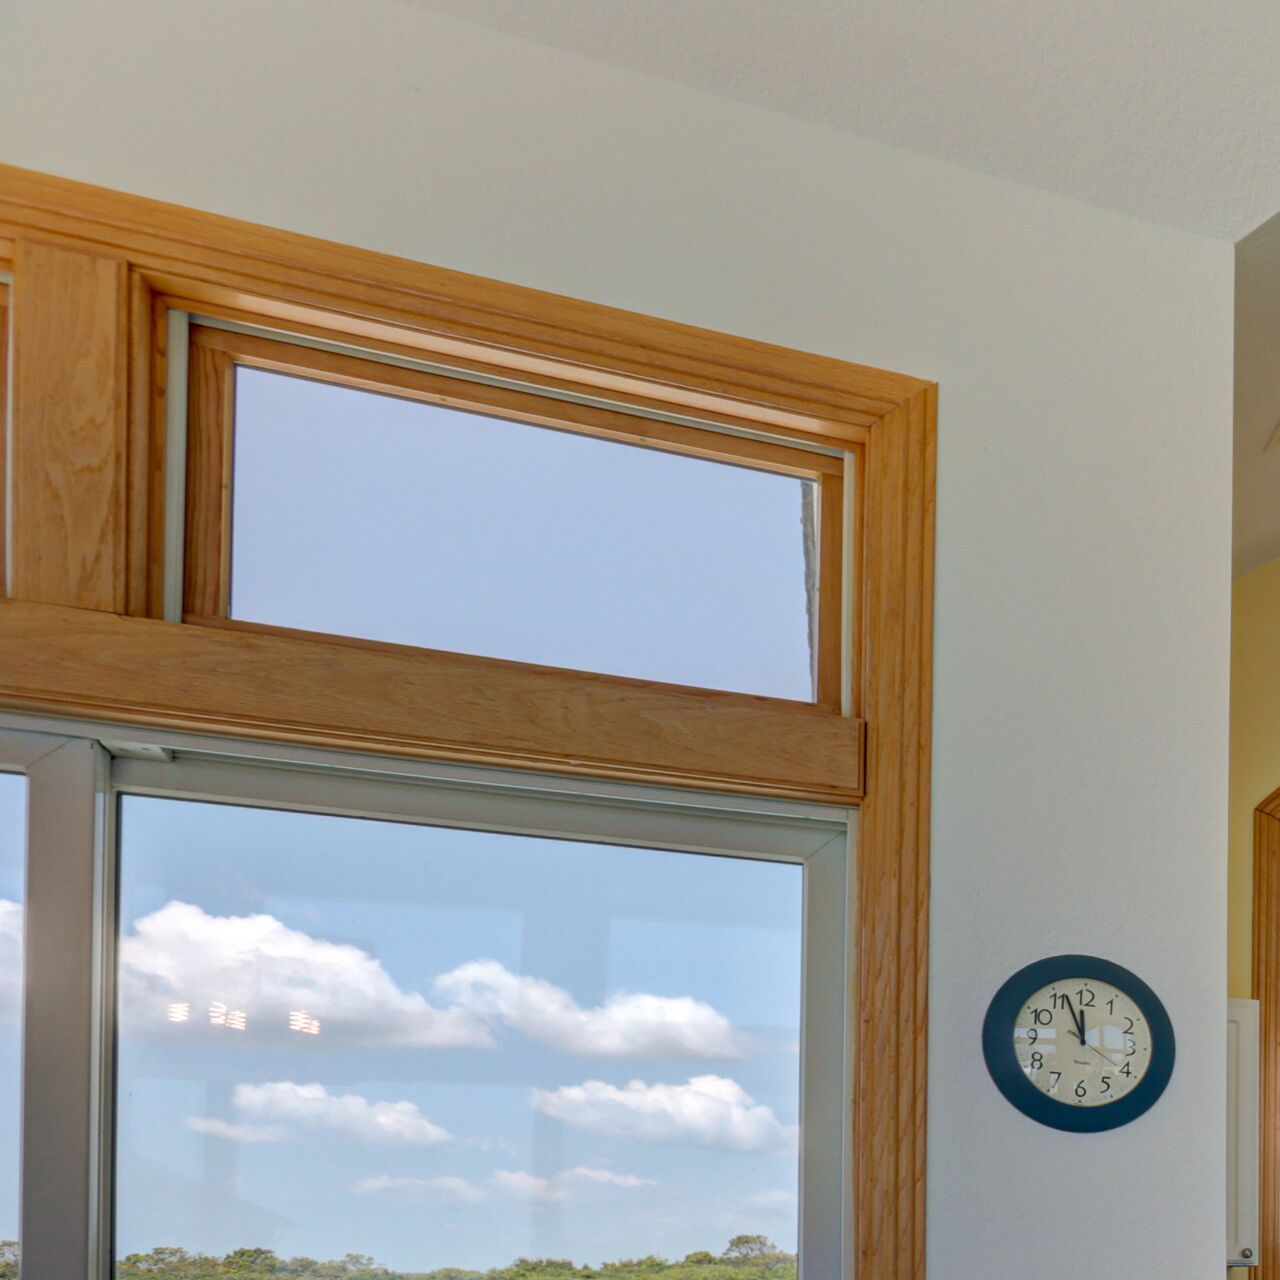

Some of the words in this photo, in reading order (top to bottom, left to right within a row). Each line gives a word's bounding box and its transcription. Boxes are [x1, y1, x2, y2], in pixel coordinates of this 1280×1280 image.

[1050, 992, 1066, 1010] 11
[1076, 988, 1095, 1007] 12
[1106, 998, 1114, 1016] 1
[1030, 1008, 1053, 1026] 10
[1122, 1017, 1134, 1035] 2
[1026, 1028, 1038, 1046] 9
[1125, 1039, 1136, 1056] 3
[1030, 1051, 1043, 1070] 8
[1119, 1061, 1132, 1078] 4
[1049, 1071, 1062, 1089] 7
[1074, 1079, 1087, 1098] 6
[1100, 1076, 1111, 1094] 5
